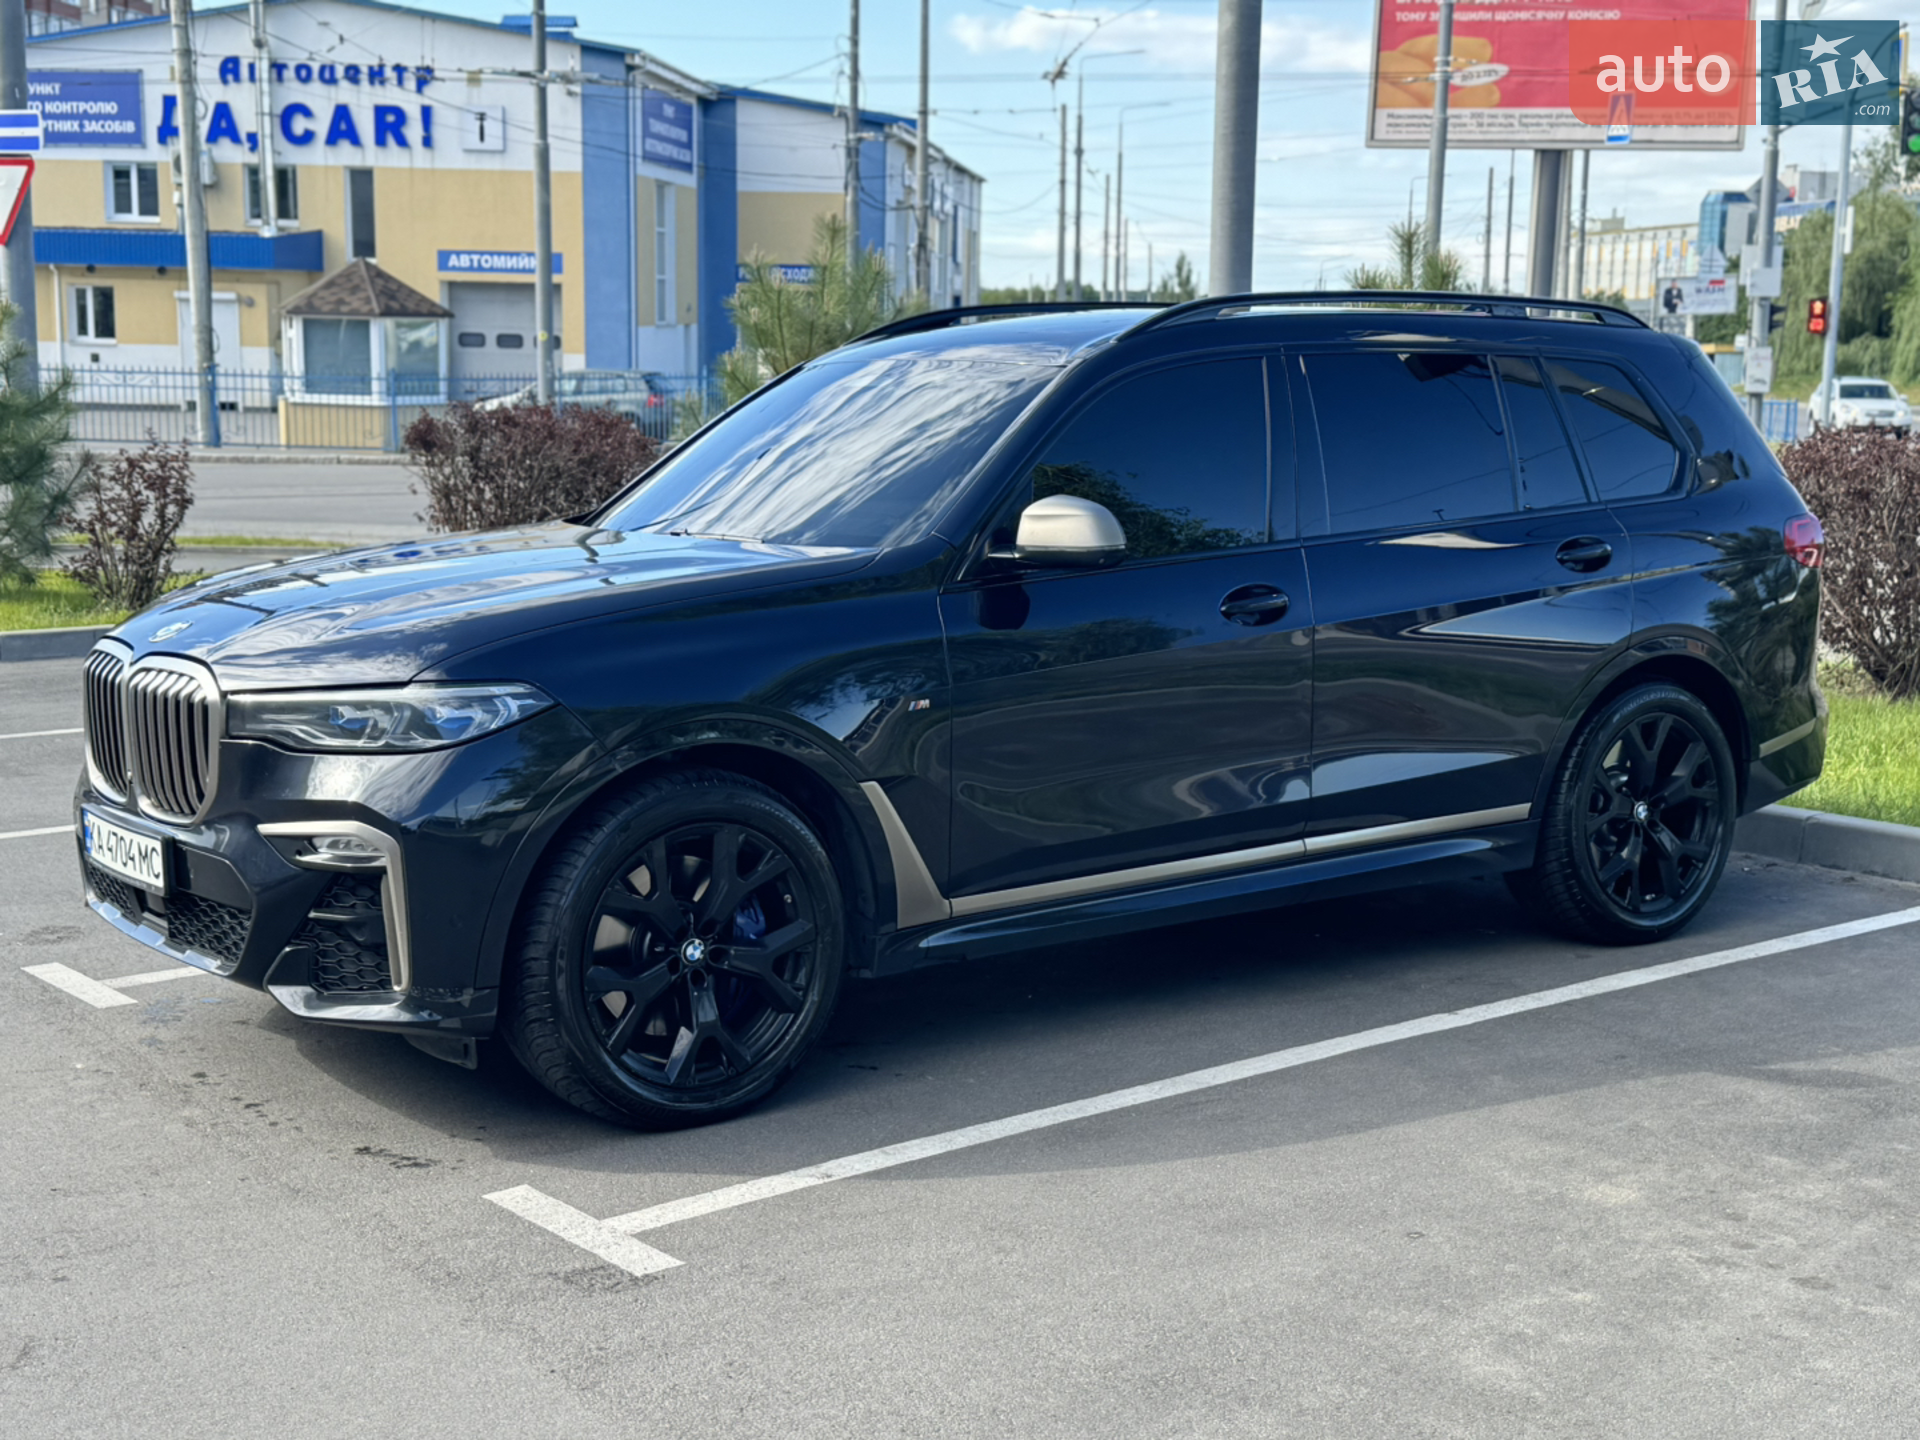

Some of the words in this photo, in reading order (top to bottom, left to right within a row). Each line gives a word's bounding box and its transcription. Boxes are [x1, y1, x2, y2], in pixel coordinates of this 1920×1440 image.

[1395, 11, 1428, 21] ТОМУ
[1567, 9, 1621, 20] КОМІСІЮ
[27, 82, 61, 95] УНКТ
[44, 101, 118, 114] КОНТРОЛЮ
[82, 121, 136, 133] ЗАСОБІВ
[280, 102, 434, 149] CAR!
[447, 253, 538, 269] АВТОМИЙК
[91, 821, 106, 858] KA
[107, 829, 137, 872] 4704
[137, 841, 162, 880] MC
